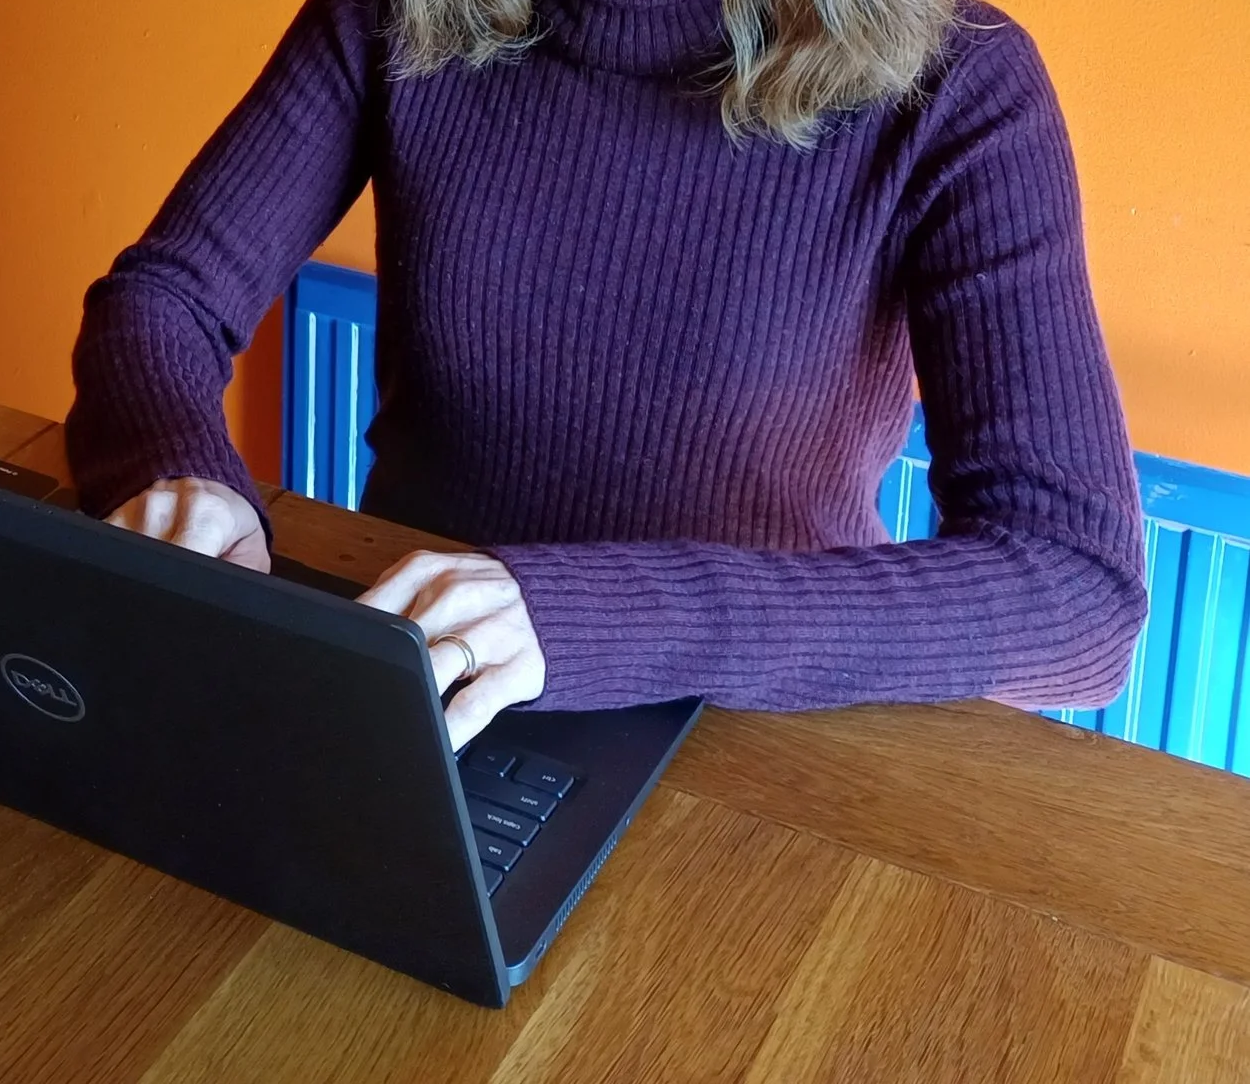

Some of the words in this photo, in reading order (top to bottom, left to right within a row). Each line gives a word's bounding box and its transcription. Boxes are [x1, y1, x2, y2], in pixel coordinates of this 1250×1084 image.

[10, 669, 77, 707] DELL
[541, 774, 556, 783] ctrl
[488, 846, 502, 855] tab
